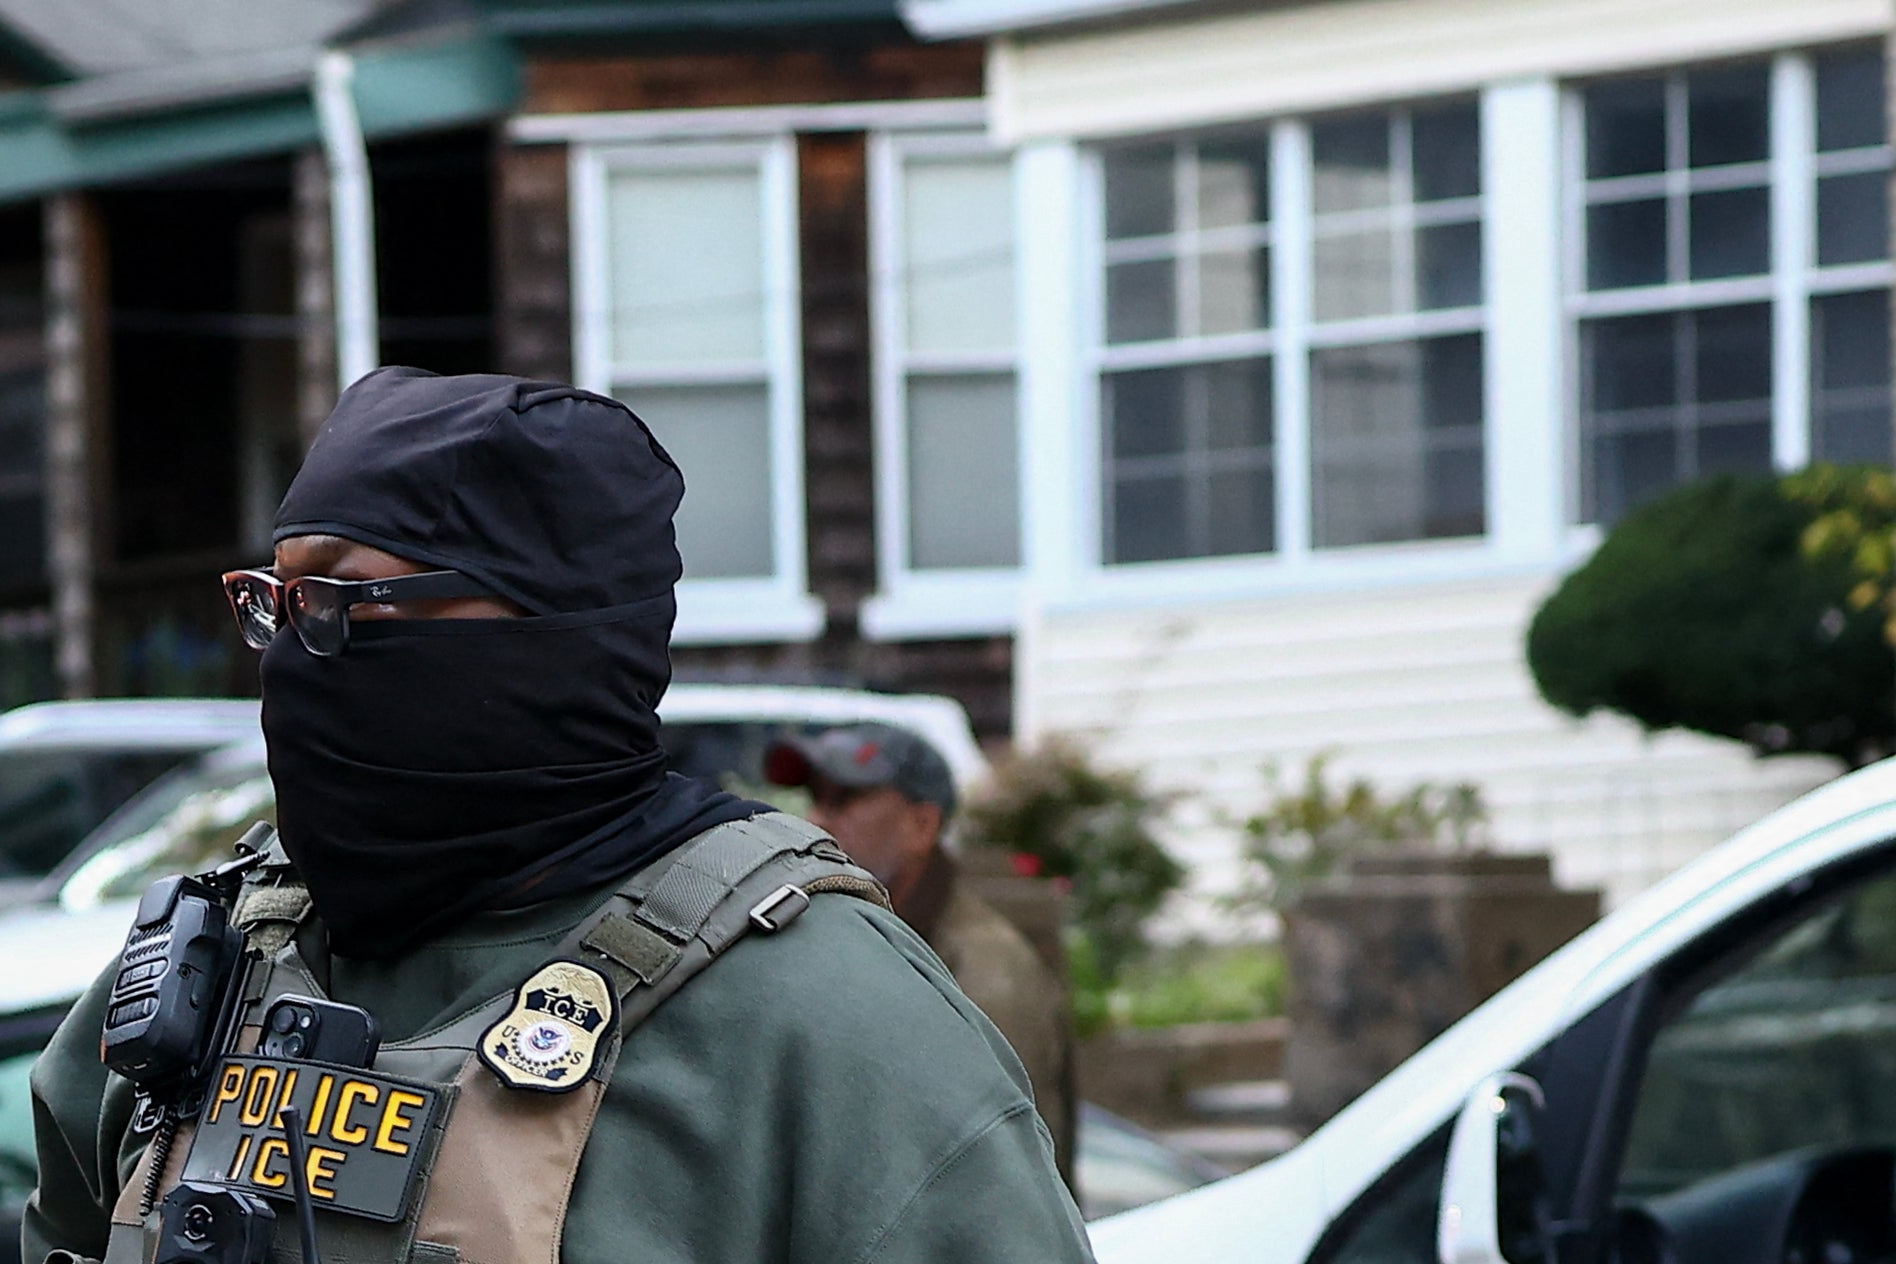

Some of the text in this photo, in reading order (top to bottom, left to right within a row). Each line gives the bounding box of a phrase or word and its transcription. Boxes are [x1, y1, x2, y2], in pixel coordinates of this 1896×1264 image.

[540, 996, 589, 1025] ICE
[502, 1025, 584, 1065] U S
[208, 1064, 425, 1155] POLICE
[226, 1135, 347, 1200] ICE
